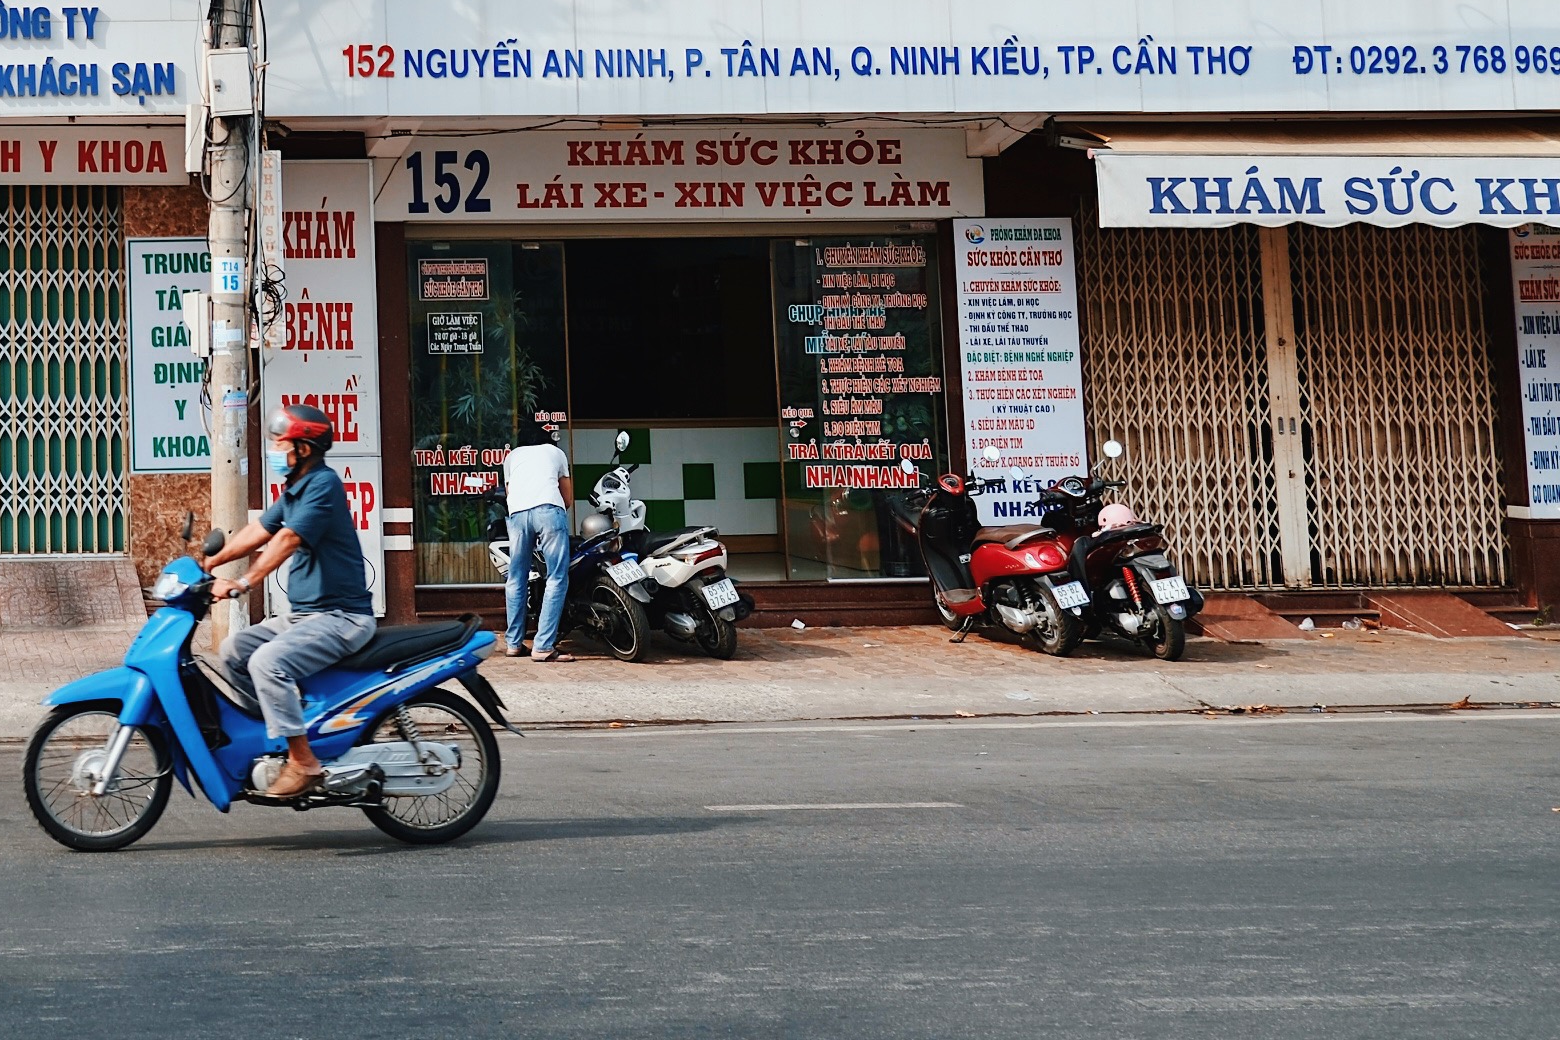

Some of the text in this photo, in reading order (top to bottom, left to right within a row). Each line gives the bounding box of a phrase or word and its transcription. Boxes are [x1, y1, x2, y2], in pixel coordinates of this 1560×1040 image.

[62, 6, 99, 40] TY
[342, 34, 1342, 79] 152 NGUYỄN AN P. TÂN NINH TP. CẦN THƠ ĐT:
[112, 62, 175, 105] SẠN
[40, 138, 58, 174] Y
[77, 138, 168, 174] KHOA
[406, 129, 902, 215] 152 KHÁM SỨC KHỎE
[516, 172, 951, 214] LÁI XE XIN VIỆC LÀM
[1146, 166, 1459, 216] KHÁM SỨC
[281, 197, 357, 260] KHÁM
[142, 252, 211, 275] TRUNG
[222, 261, 240, 272] T14
[967, 245, 1063, 267] SỨC KHỎE CẦN THƠ
[221, 275, 239, 291] 15
[1519, 273, 1542, 301] KHÁM
[968, 298, 980, 307] XIN
[281, 288, 355, 363] BỆNH
[789, 305, 824, 326] CHỤP
[1012, 324, 1029, 333] THAO
[154, 362, 205, 389] ĐỊNH
[174, 399, 188, 421] Y
[551, 412, 567, 422] QUA
[153, 435, 210, 458] KHOA
[415, 444, 478, 466] TRẢ KẾT
[788, 437, 932, 460] TRẢ QUẢ
